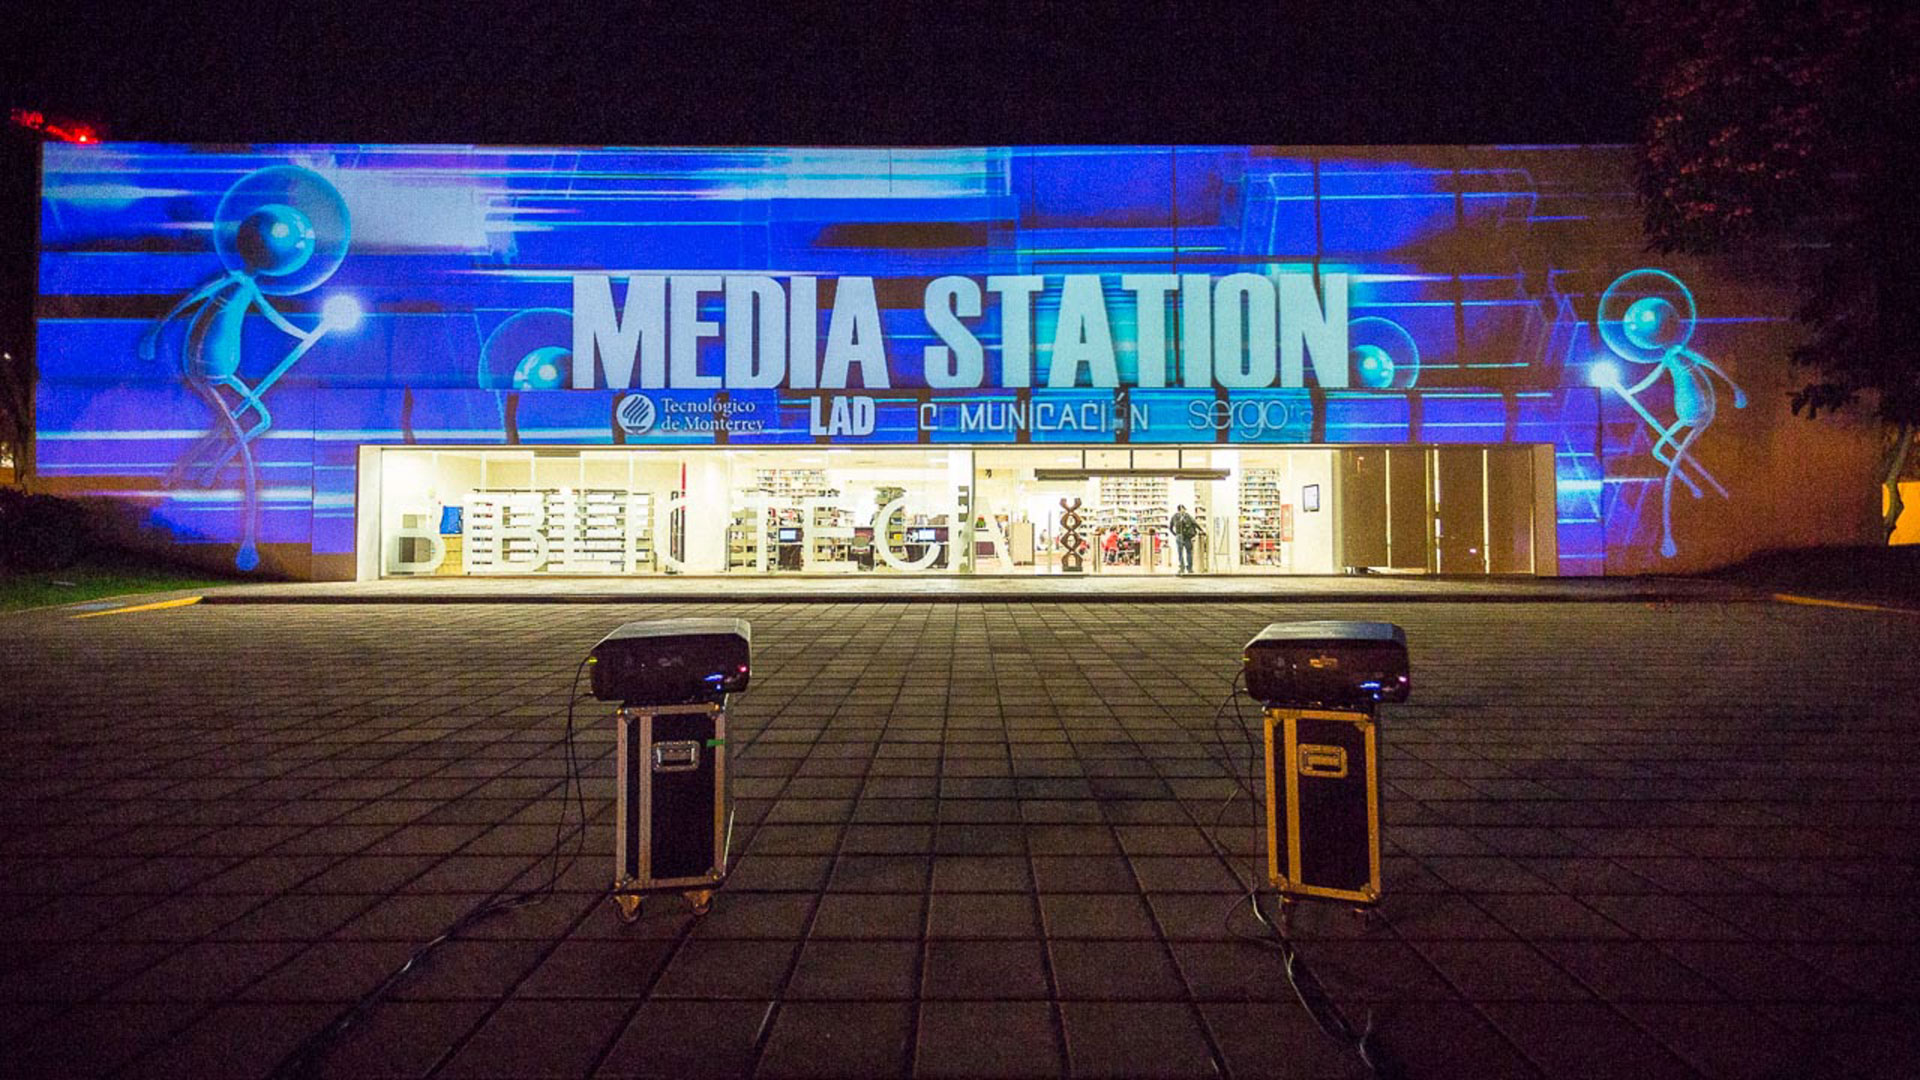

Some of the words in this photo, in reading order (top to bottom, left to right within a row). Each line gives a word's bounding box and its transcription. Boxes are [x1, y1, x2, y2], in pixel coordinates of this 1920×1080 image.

[572, 275, 890, 389] MEDIA
[923, 272, 1348, 389] STATION
[662, 397, 756, 416] Tecnológico
[810, 396, 876, 436] LAD
[661, 416, 677, 432] de
[681, 416, 765, 434] Monterrey
